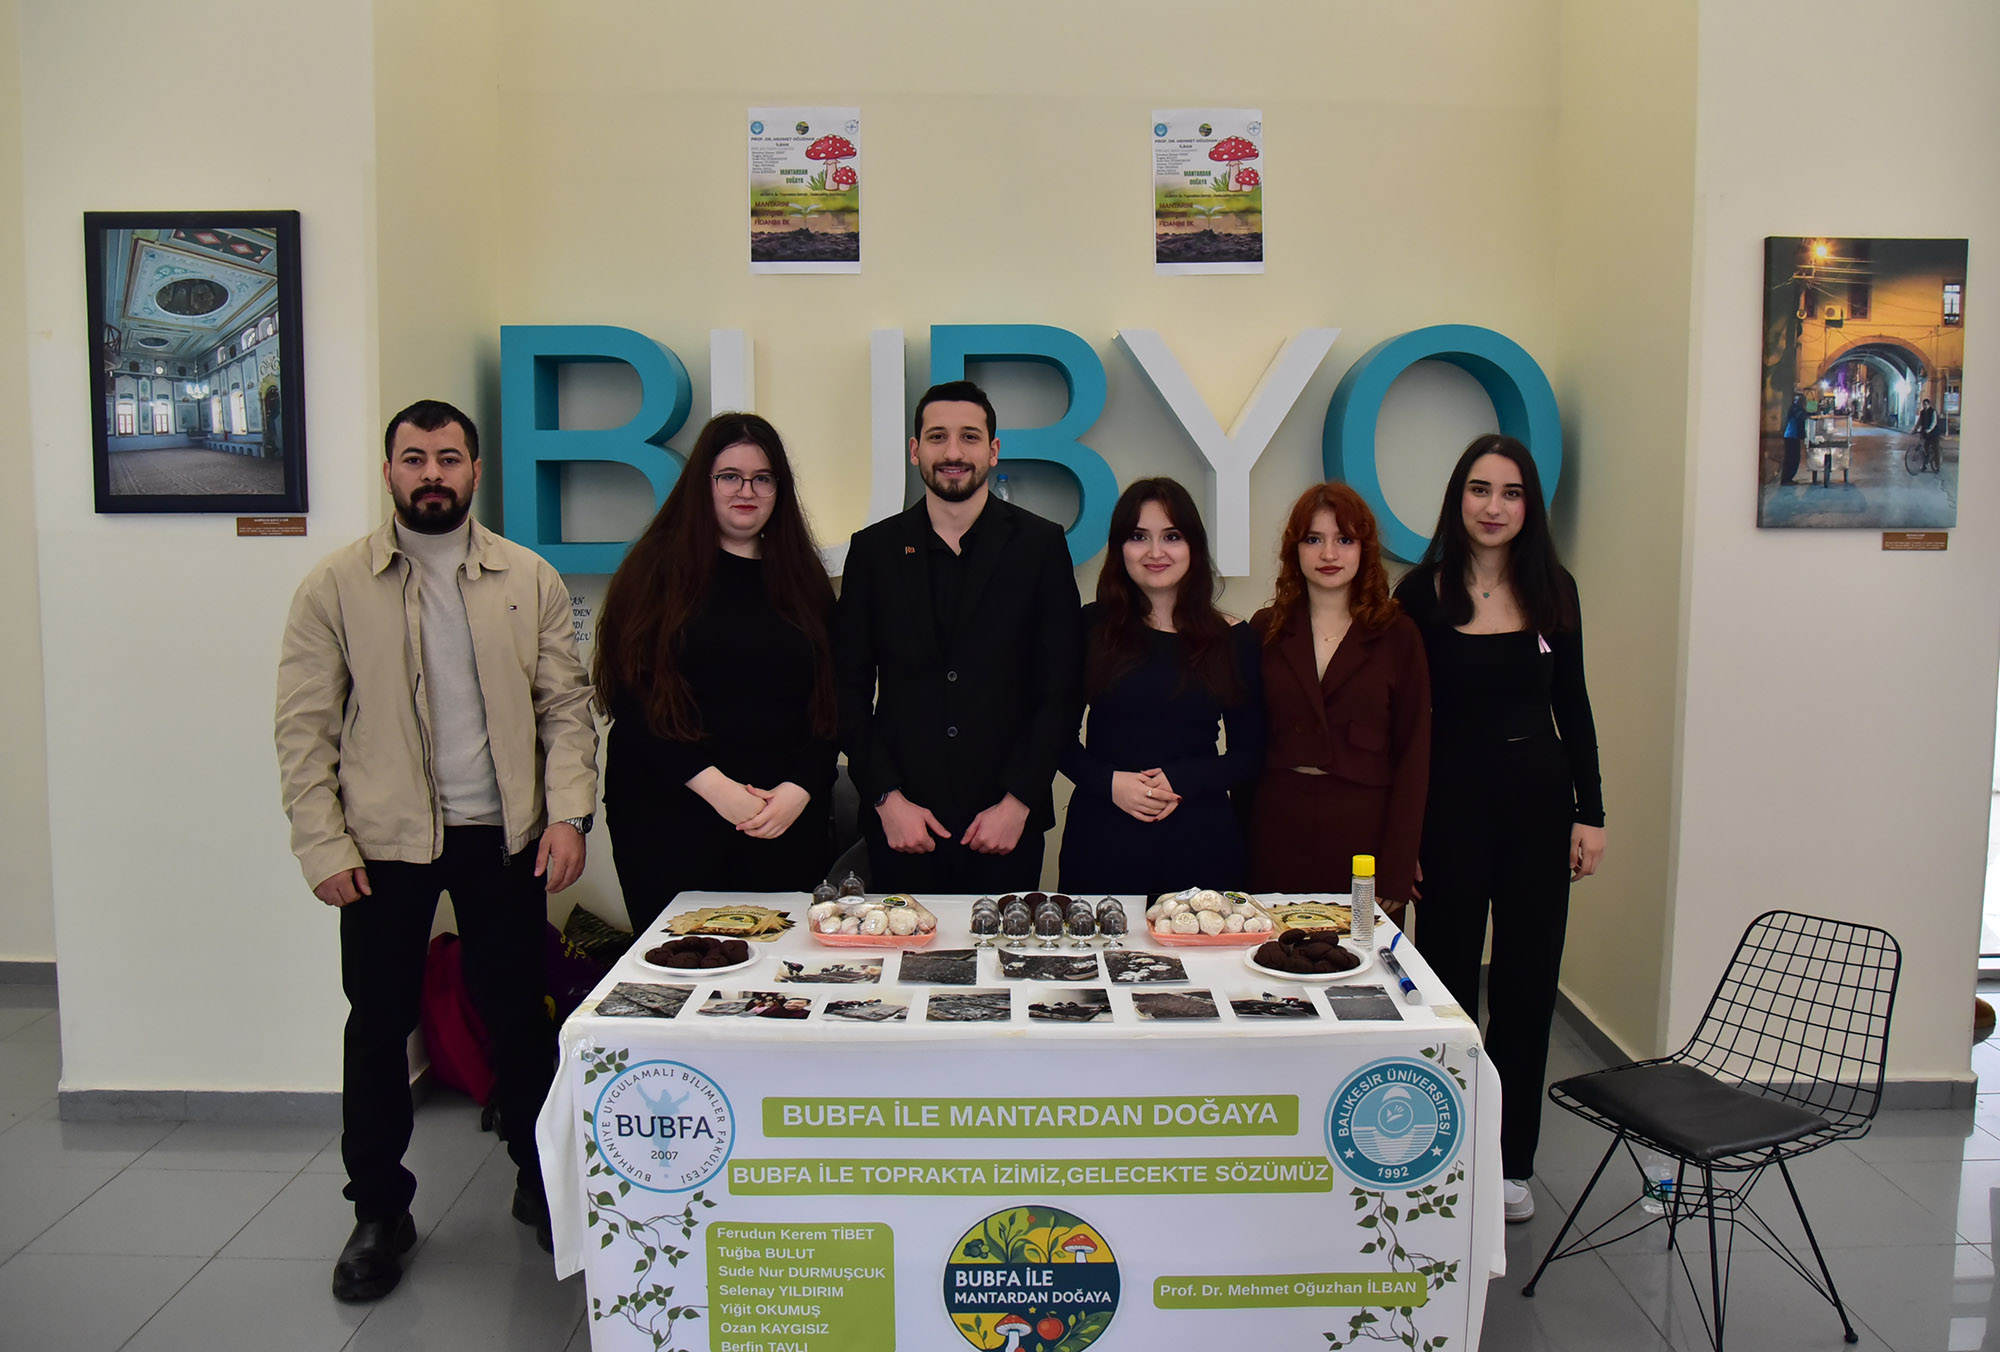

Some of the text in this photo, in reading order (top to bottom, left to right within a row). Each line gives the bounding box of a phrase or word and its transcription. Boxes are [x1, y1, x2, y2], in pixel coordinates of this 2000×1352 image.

[1338, 1068, 1451, 1137] BALIKESİR ÜNİVERSİTESİ
[783, 1098, 1279, 1127] BUBFA İLE MANTARDAN DOĞAYA
[602, 1068, 727, 1184] BURHANİYE UYGULAMALI BİLİMLER FAKÜLTESİ
[615, 1114, 714, 1139] BUBFA
[650, 1150, 679, 1160] 2007
[733, 1160, 1329, 1187] BUBFA İLE TOPRAKTA İZİMİZ,GELECEKTE SÖZÜMÜZ
[1377, 1166, 1409, 1178] 1992
[717, 1226, 875, 1241] Ferudun Kerem TİBET
[717, 1246, 815, 1261] Tuğba BULUT
[718, 1265, 886, 1281] Sude Nur DURMUŞCUK
[955, 1266, 1054, 1287] BUBFA İLE
[719, 1284, 844, 1299] Selenay YILDIRIM
[954, 1288, 1112, 1304] MANTARDAN DOĞAYA
[1160, 1279, 1417, 1297] Prof. Dr. Mehmet Oğuzhan İLBAN
[720, 1303, 821, 1319] Yiğit OKUMUŞ
[720, 1322, 829, 1335] Ozan KAYGISIZ
[721, 1341, 808, 1352] Berfin TAVLI
